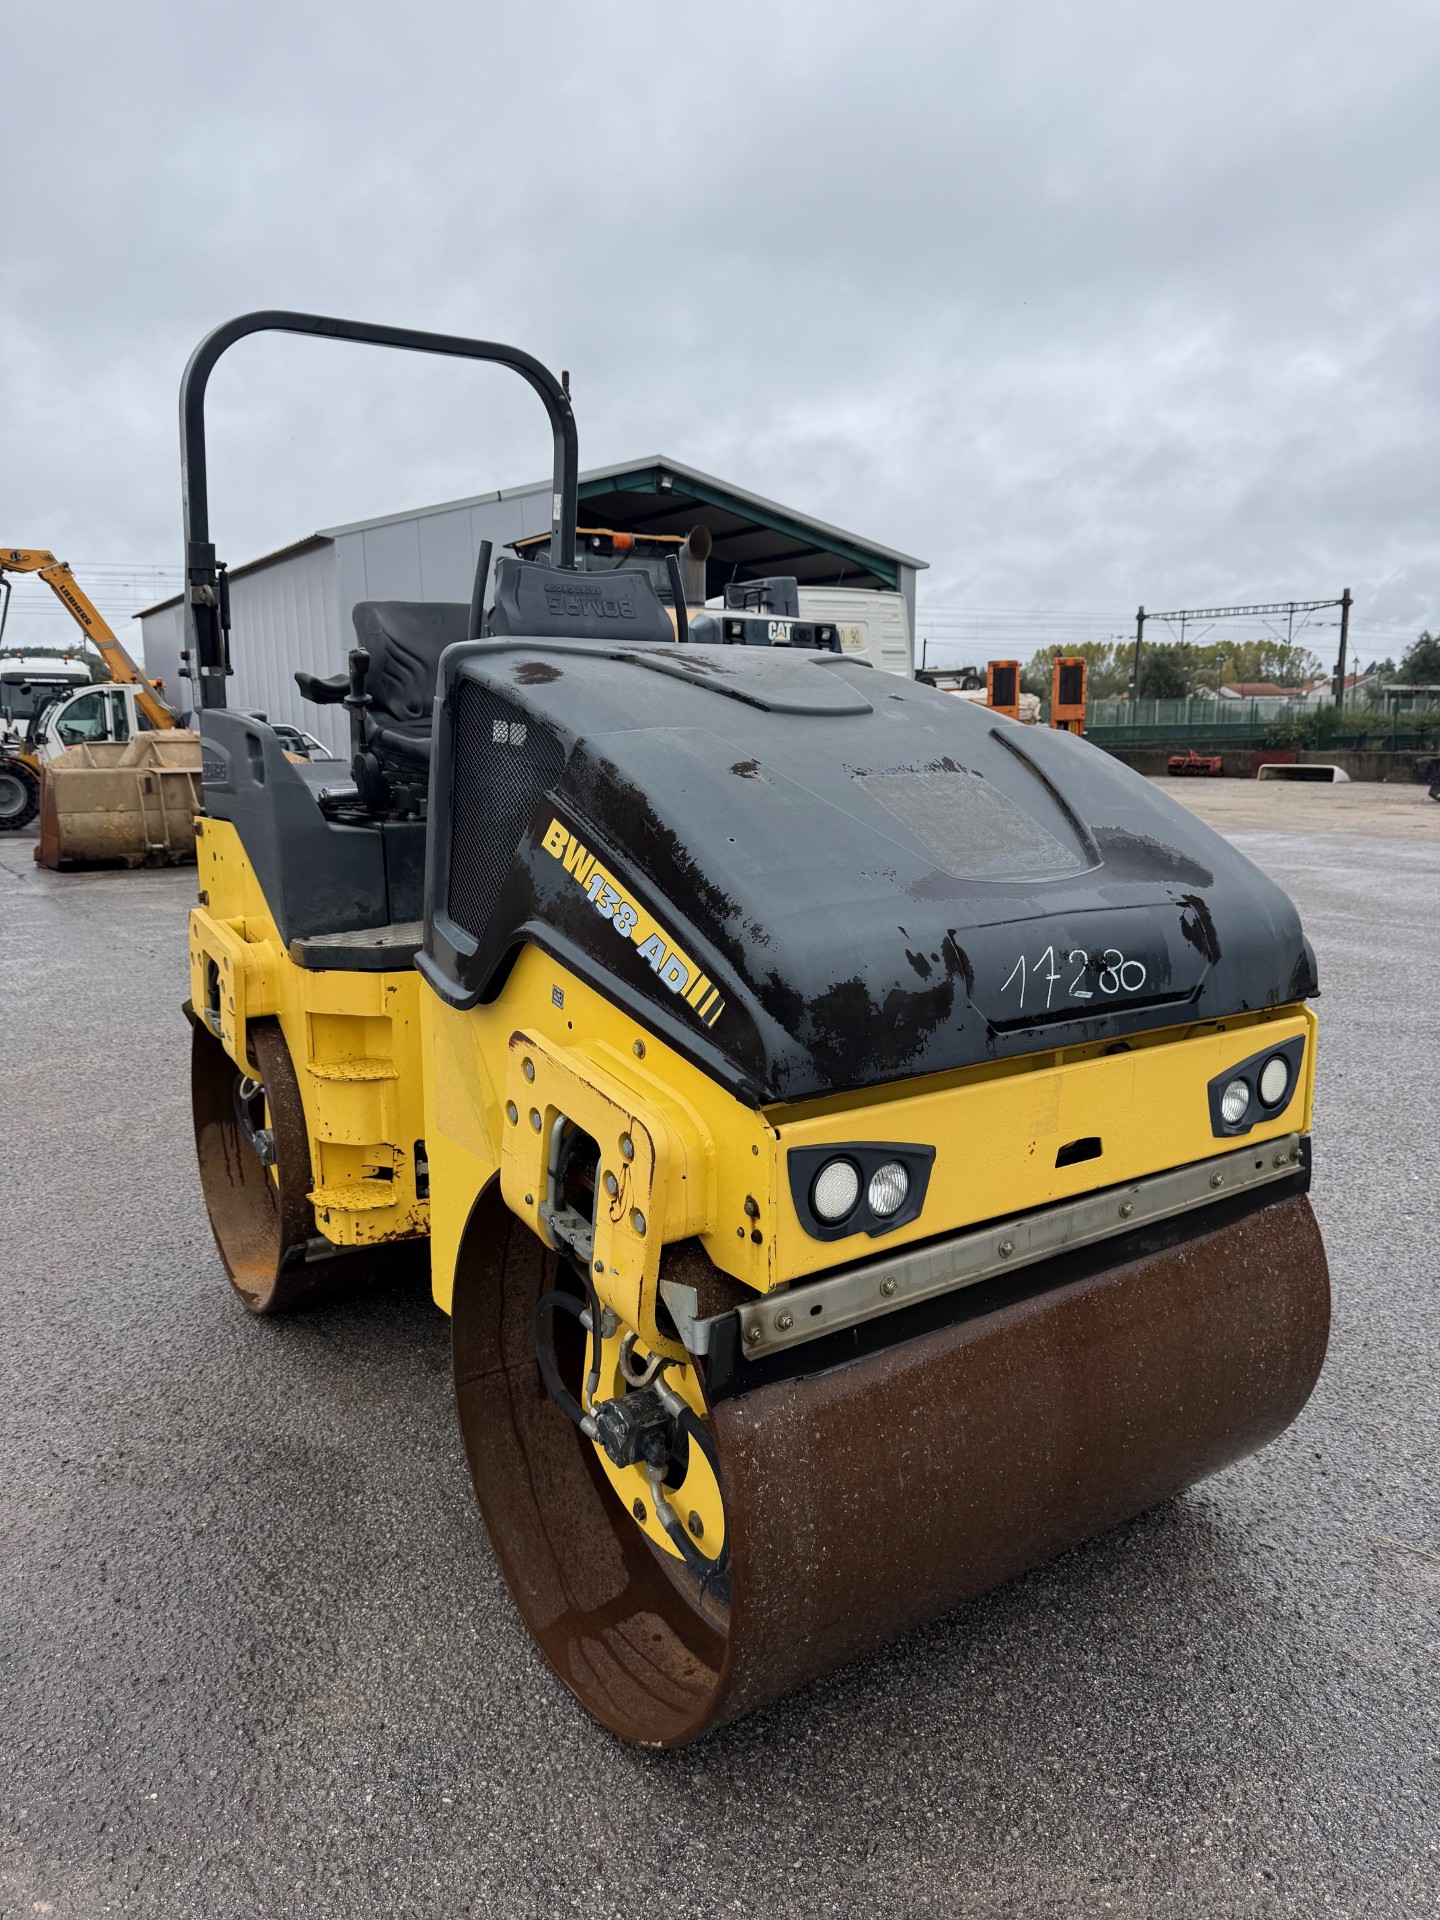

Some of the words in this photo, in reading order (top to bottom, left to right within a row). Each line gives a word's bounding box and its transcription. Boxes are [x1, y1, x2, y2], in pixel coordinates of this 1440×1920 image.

[59, 585, 92, 626] LIEBHERR
[546, 594, 637, 619] BOMAG
[768, 621, 793, 641] CAT
[1000, 945, 1147, 1009] 17280
